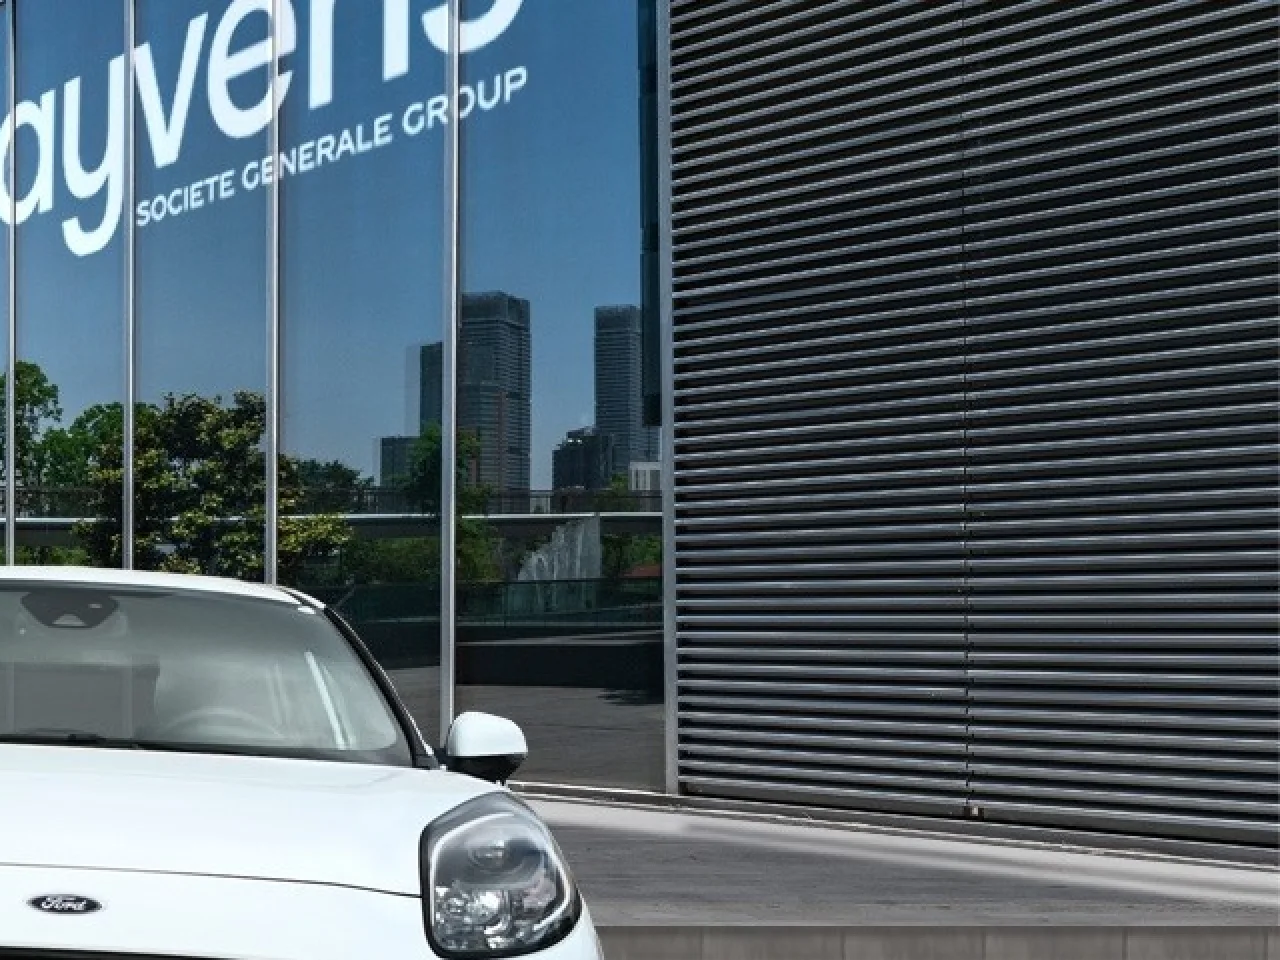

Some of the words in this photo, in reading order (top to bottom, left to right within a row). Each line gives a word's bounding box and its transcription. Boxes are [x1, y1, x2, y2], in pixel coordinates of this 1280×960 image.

[135, 168, 236, 227] SOCIETE
[240, 112, 393, 191] GENERALE
[401, 65, 528, 136] GROUP
